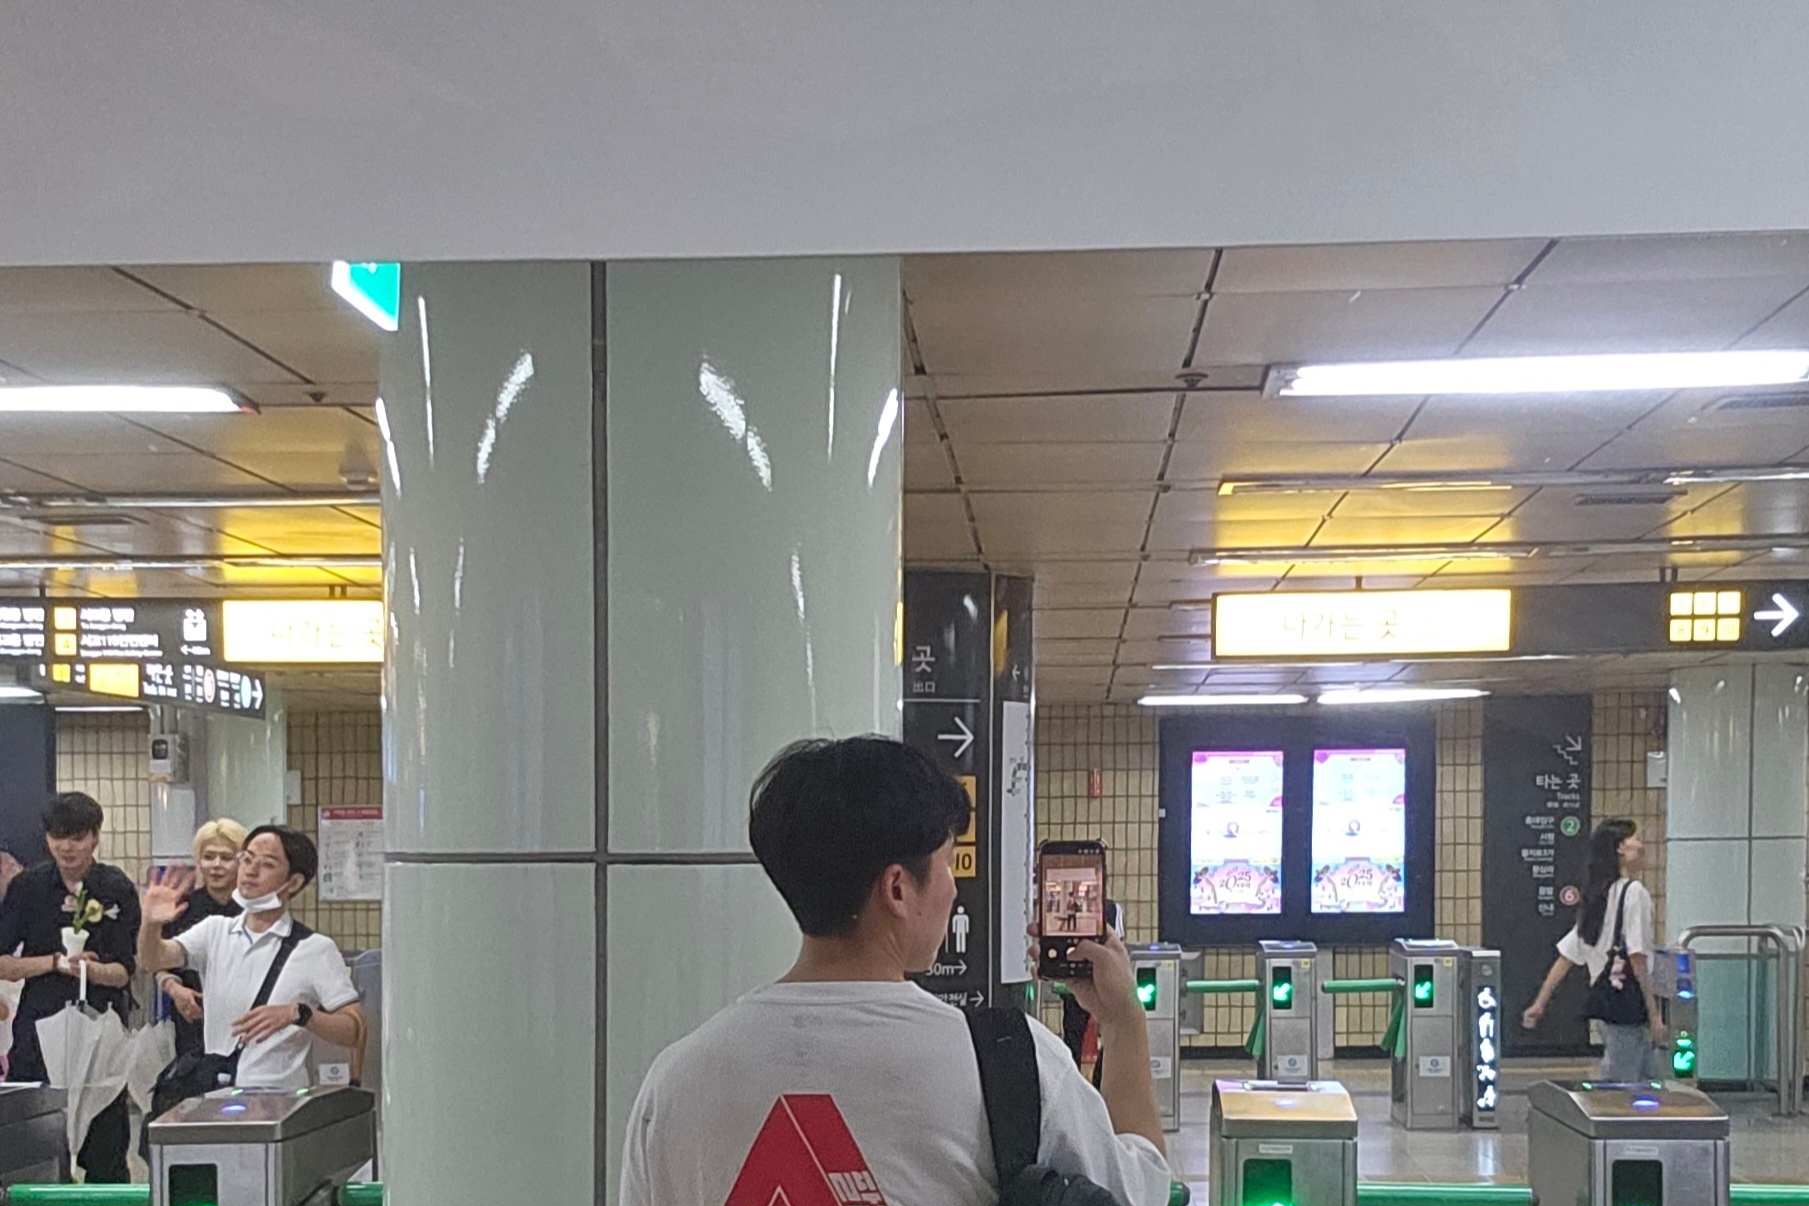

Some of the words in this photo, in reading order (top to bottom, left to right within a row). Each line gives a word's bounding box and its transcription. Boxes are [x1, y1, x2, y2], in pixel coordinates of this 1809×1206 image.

[1283, 610, 1364, 642] 나가는
[1378, 608, 1401, 641] 곳
[912, 645, 935, 672] 곳
[913, 681, 935, 693] 出口
[1536, 774, 1563, 790] 타는
[1566, 773, 1581, 790] 곳
[1566, 819, 1575, 832] 2
[955, 853, 972, 871] 10
[1564, 889, 1575, 902] 6
